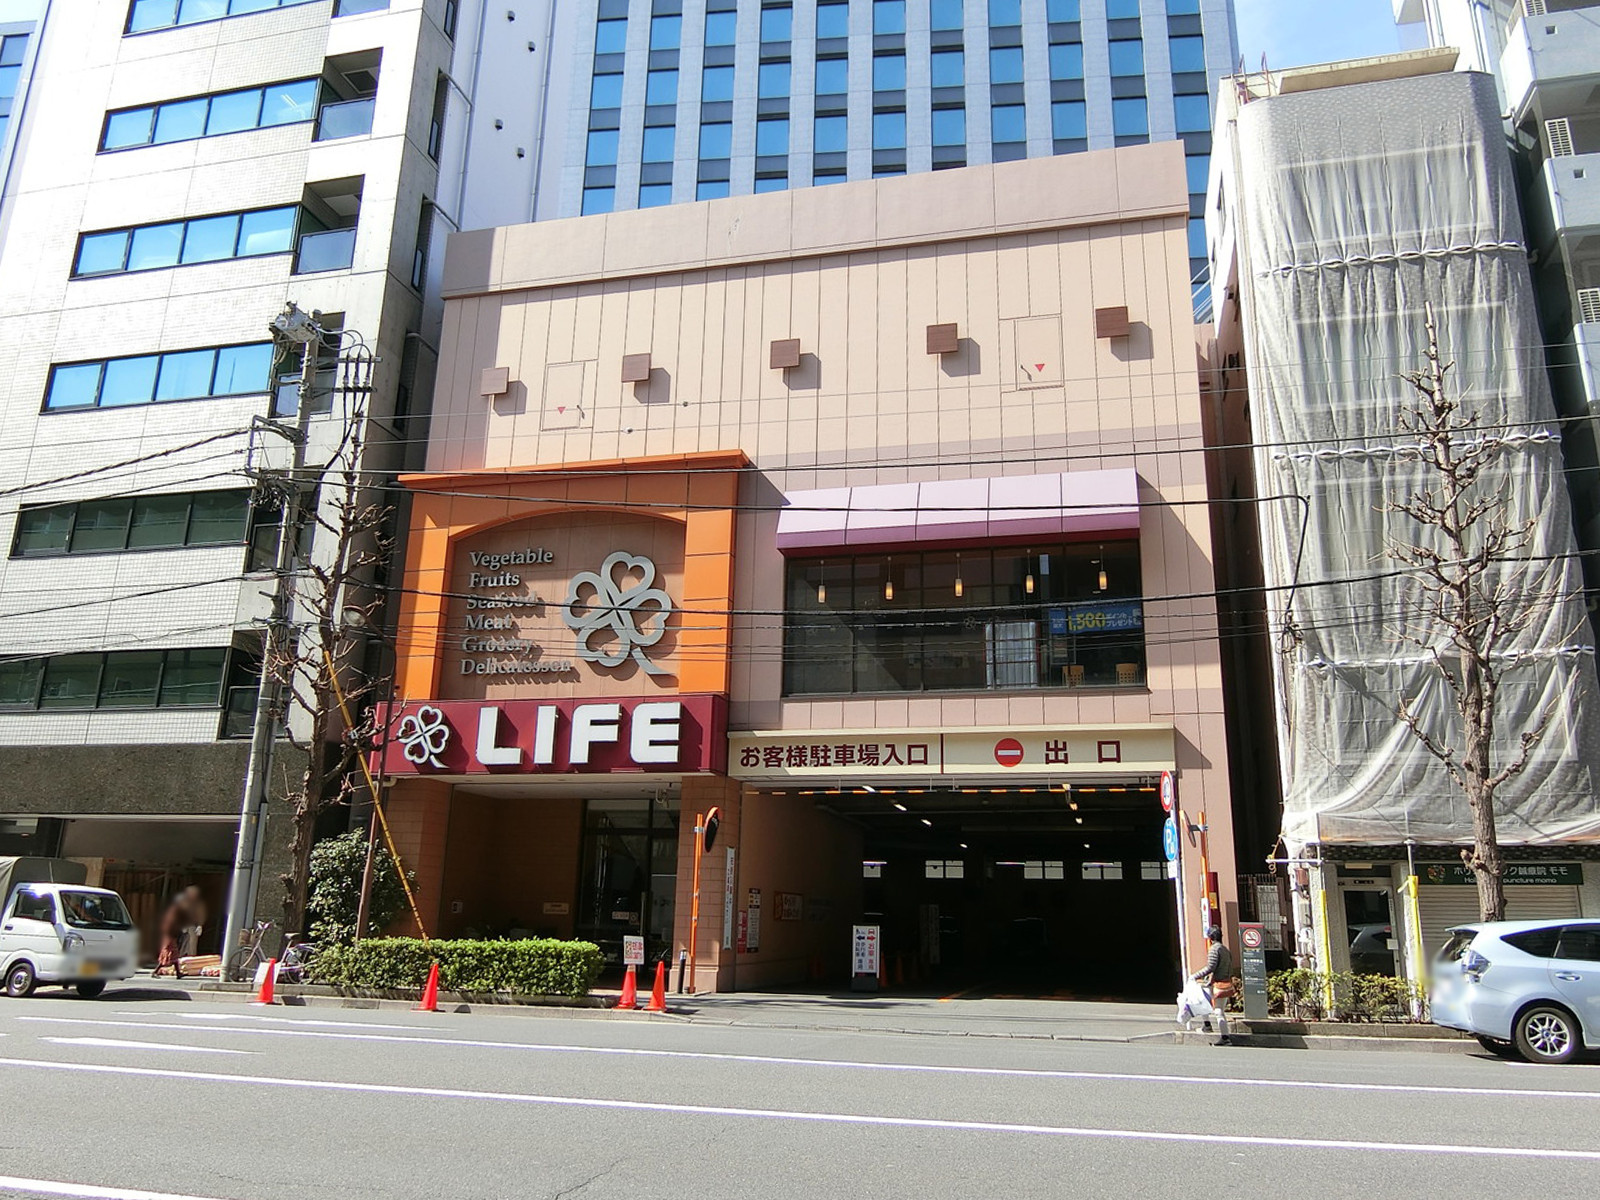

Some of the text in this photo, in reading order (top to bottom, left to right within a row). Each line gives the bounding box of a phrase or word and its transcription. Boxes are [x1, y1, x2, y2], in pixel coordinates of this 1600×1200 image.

[469, 547, 554, 570] Vegetable
[468, 571, 521, 588] Fruits
[466, 591, 537, 609] Seafood
[464, 614, 513, 631] Meat
[1068, 612, 1106, 631] 1,500
[461, 636, 534, 655] Grocery
[460, 657, 572, 675] Delicatessen
[476, 702, 682, 764] LIFE
[740, 743, 929, 768] お客様駐車場入口
[1044, 739, 1121, 764] 出口
[1549, 866, 1569, 876] モモ
